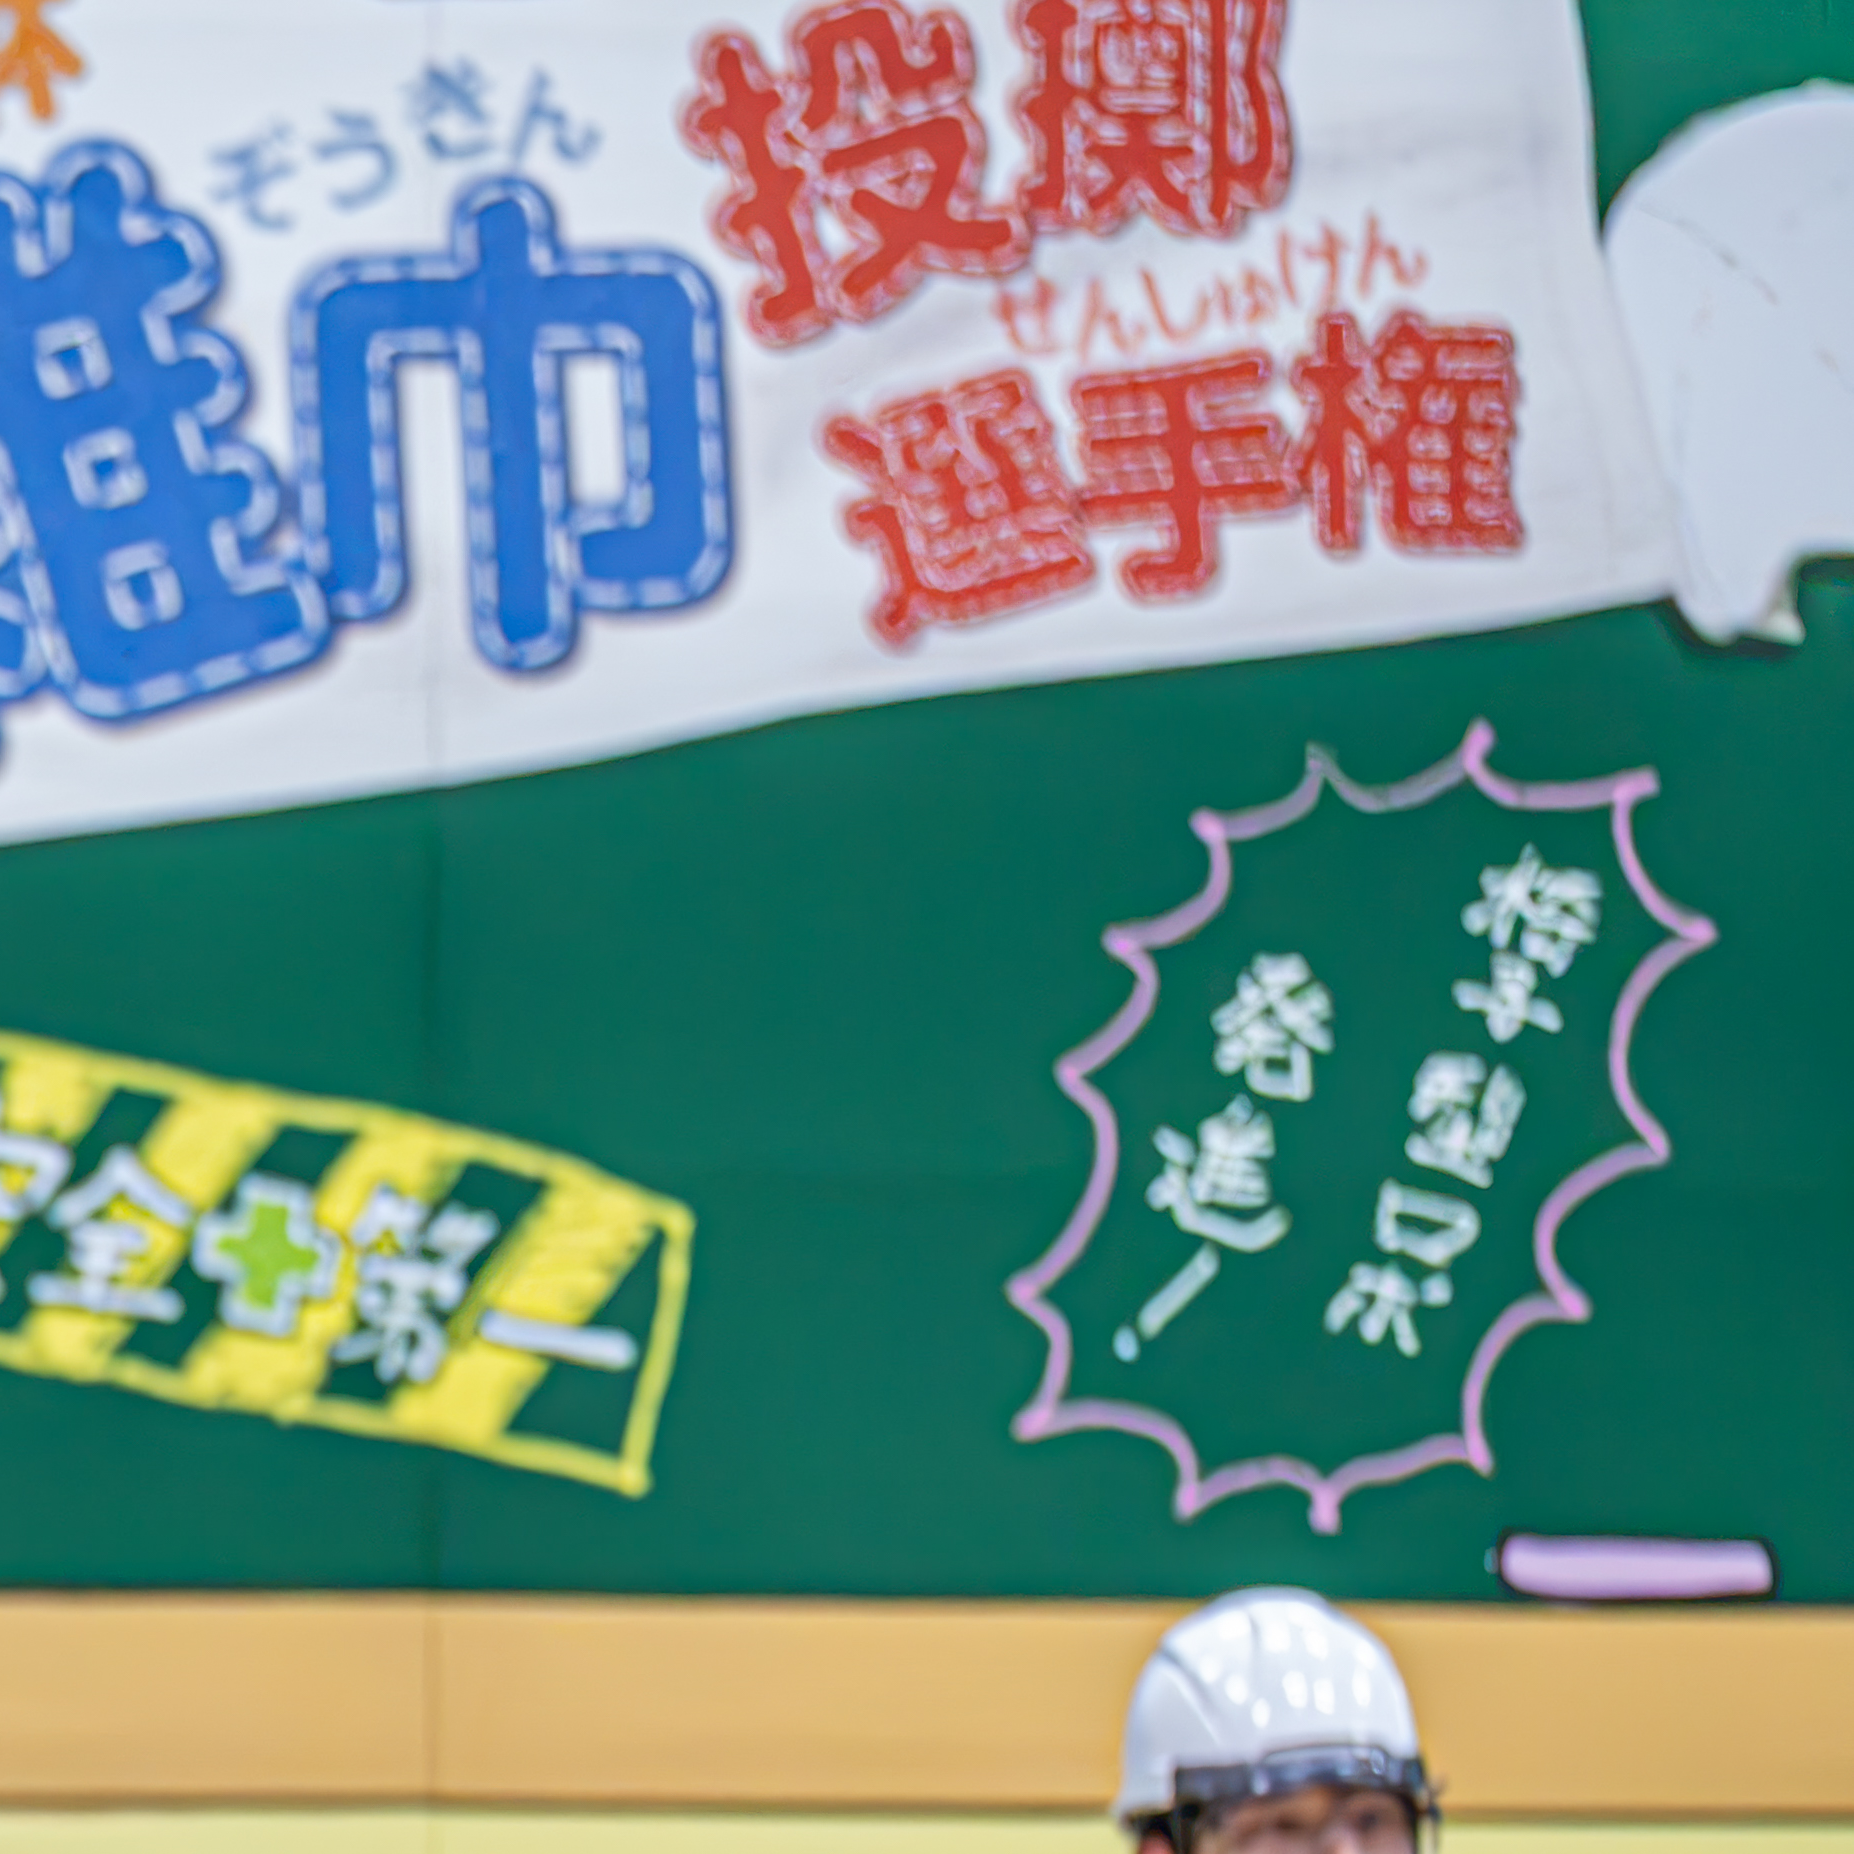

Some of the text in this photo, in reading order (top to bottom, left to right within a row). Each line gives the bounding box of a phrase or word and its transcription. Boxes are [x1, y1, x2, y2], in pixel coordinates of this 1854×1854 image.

[207, 56, 602, 232] ぞうきん
[994, 210, 1428, 358] せんしゅけん
[820, 308, 1527, 655] 選手権
